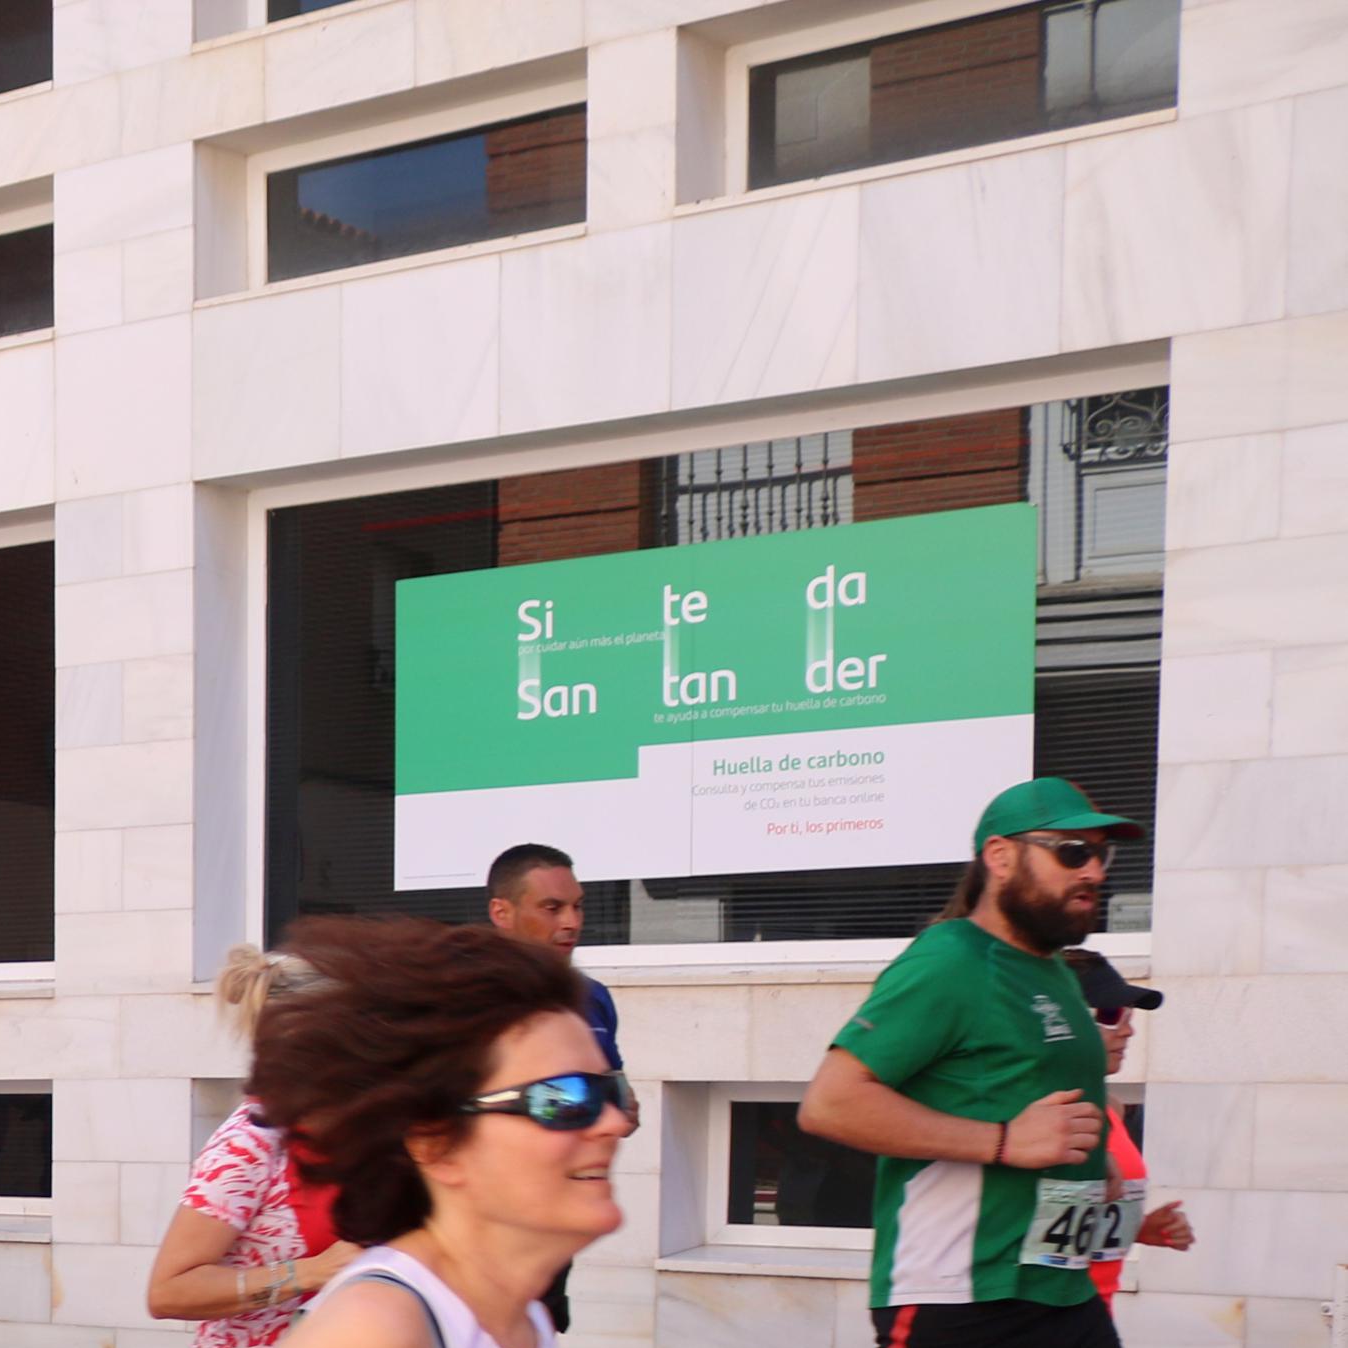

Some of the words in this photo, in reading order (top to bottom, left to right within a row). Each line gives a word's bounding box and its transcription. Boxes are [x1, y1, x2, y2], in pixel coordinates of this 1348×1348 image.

[517, 599, 554, 642] Si
[663, 584, 708, 626] te
[806, 564, 867, 610] da
[590, 636, 612, 648] más
[613, 633, 624, 646] el
[517, 678, 597, 720] San
[663, 664, 737, 707] tan
[805, 650, 887, 694] der
[667, 709, 699, 724] ayuda
[701, 711, 707, 719] a
[709, 702, 770, 720] compensar
[772, 703, 783, 713] tu
[786, 699, 820, 712] huella
[823, 696, 836, 708] de
[839, 692, 887, 706] carbono
[713, 756, 772, 776] Huella
[779, 754, 801, 771] de
[807, 750, 885, 769] carbono
[691, 783, 739, 797] Consulta
[740, 785, 747, 795] y
[749, 779, 805, 793] compensa
[808, 777, 825, 788] tus
[827, 772, 885, 786] emisiones
[744, 799, 755, 811] de
[783, 798, 796, 808] en
[799, 796, 811, 807] tu
[813, 794, 846, 807] banca
[849, 791, 885, 805] online
[767, 822, 788, 835] Por
[805, 820, 824, 834] los
[826, 817, 884, 836] primeros
